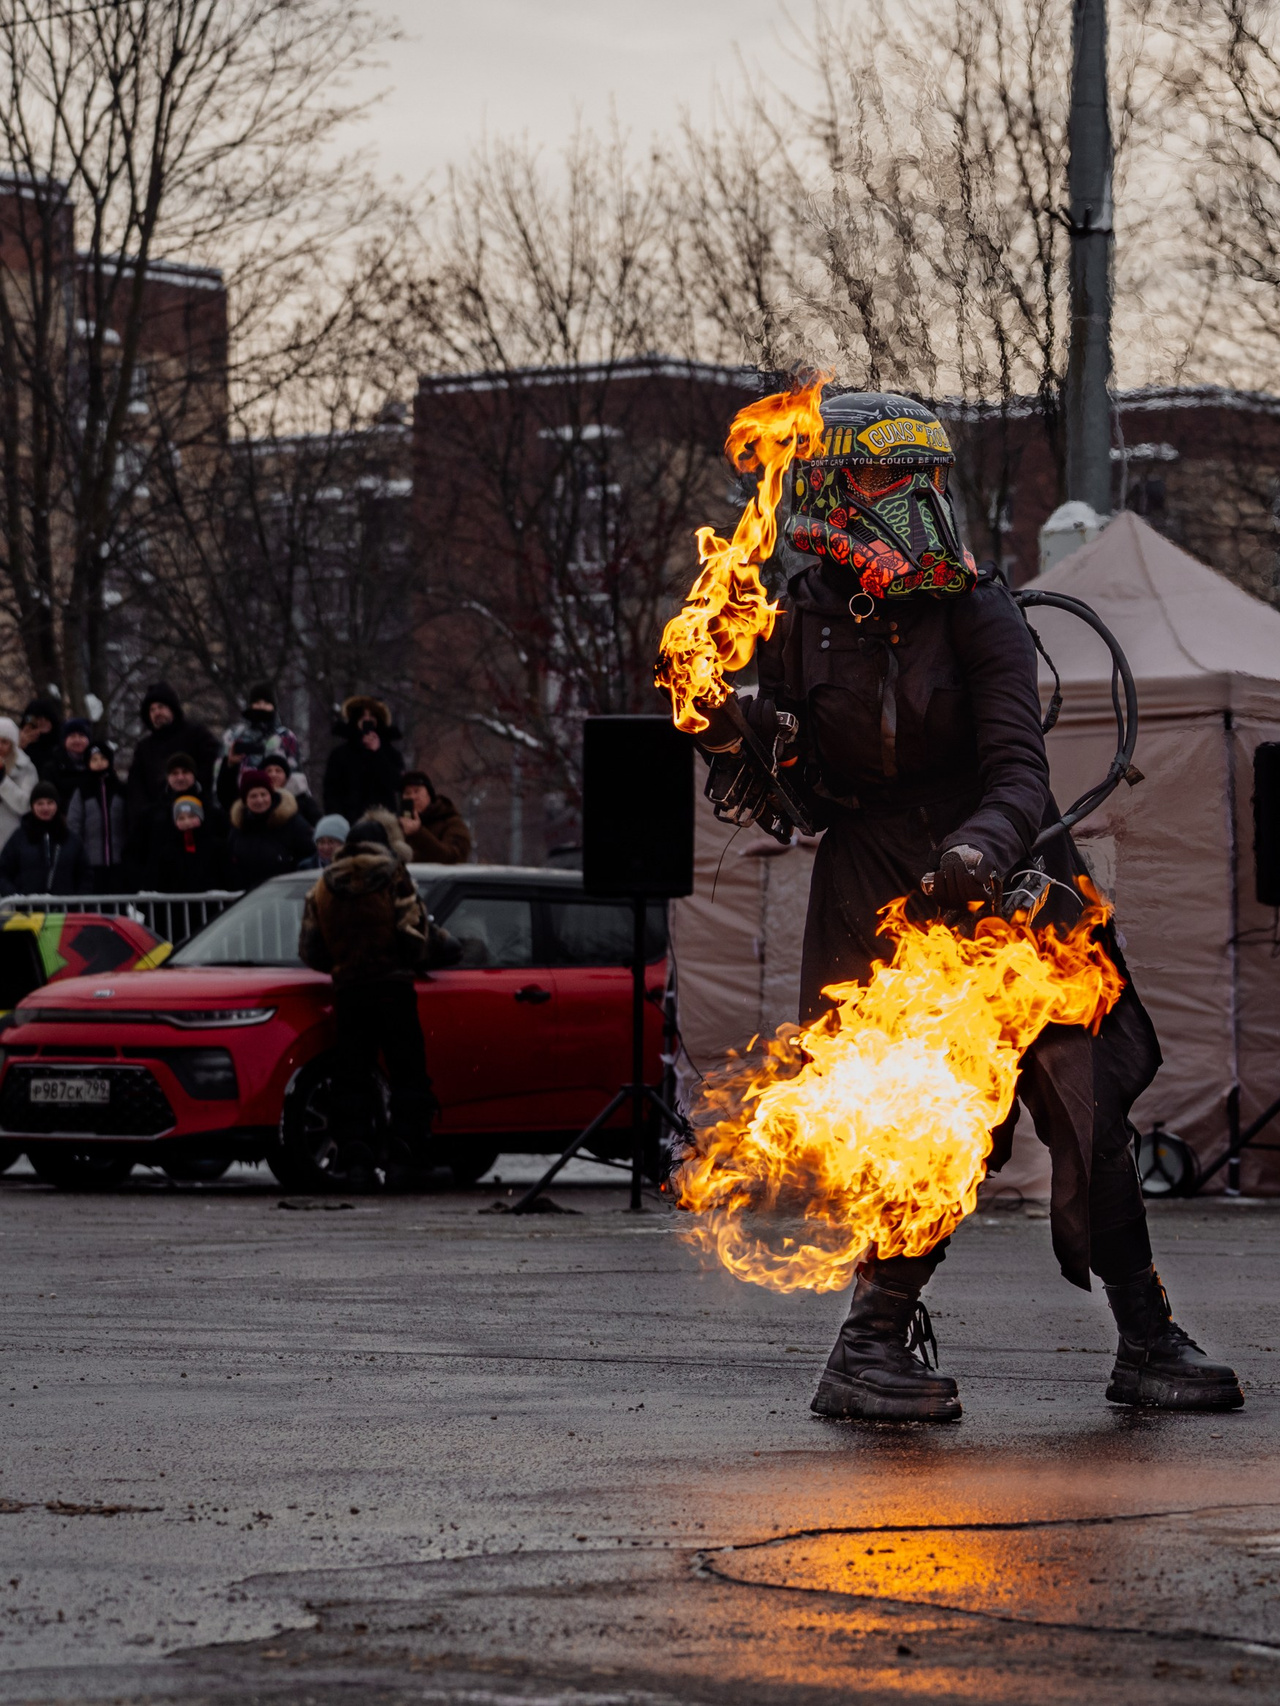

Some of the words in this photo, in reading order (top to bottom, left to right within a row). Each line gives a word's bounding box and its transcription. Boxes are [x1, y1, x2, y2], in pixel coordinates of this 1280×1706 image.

[868, 421, 916, 448] GUNS
[852, 457, 873, 466] YOU
[880, 457, 914, 465] COULD
